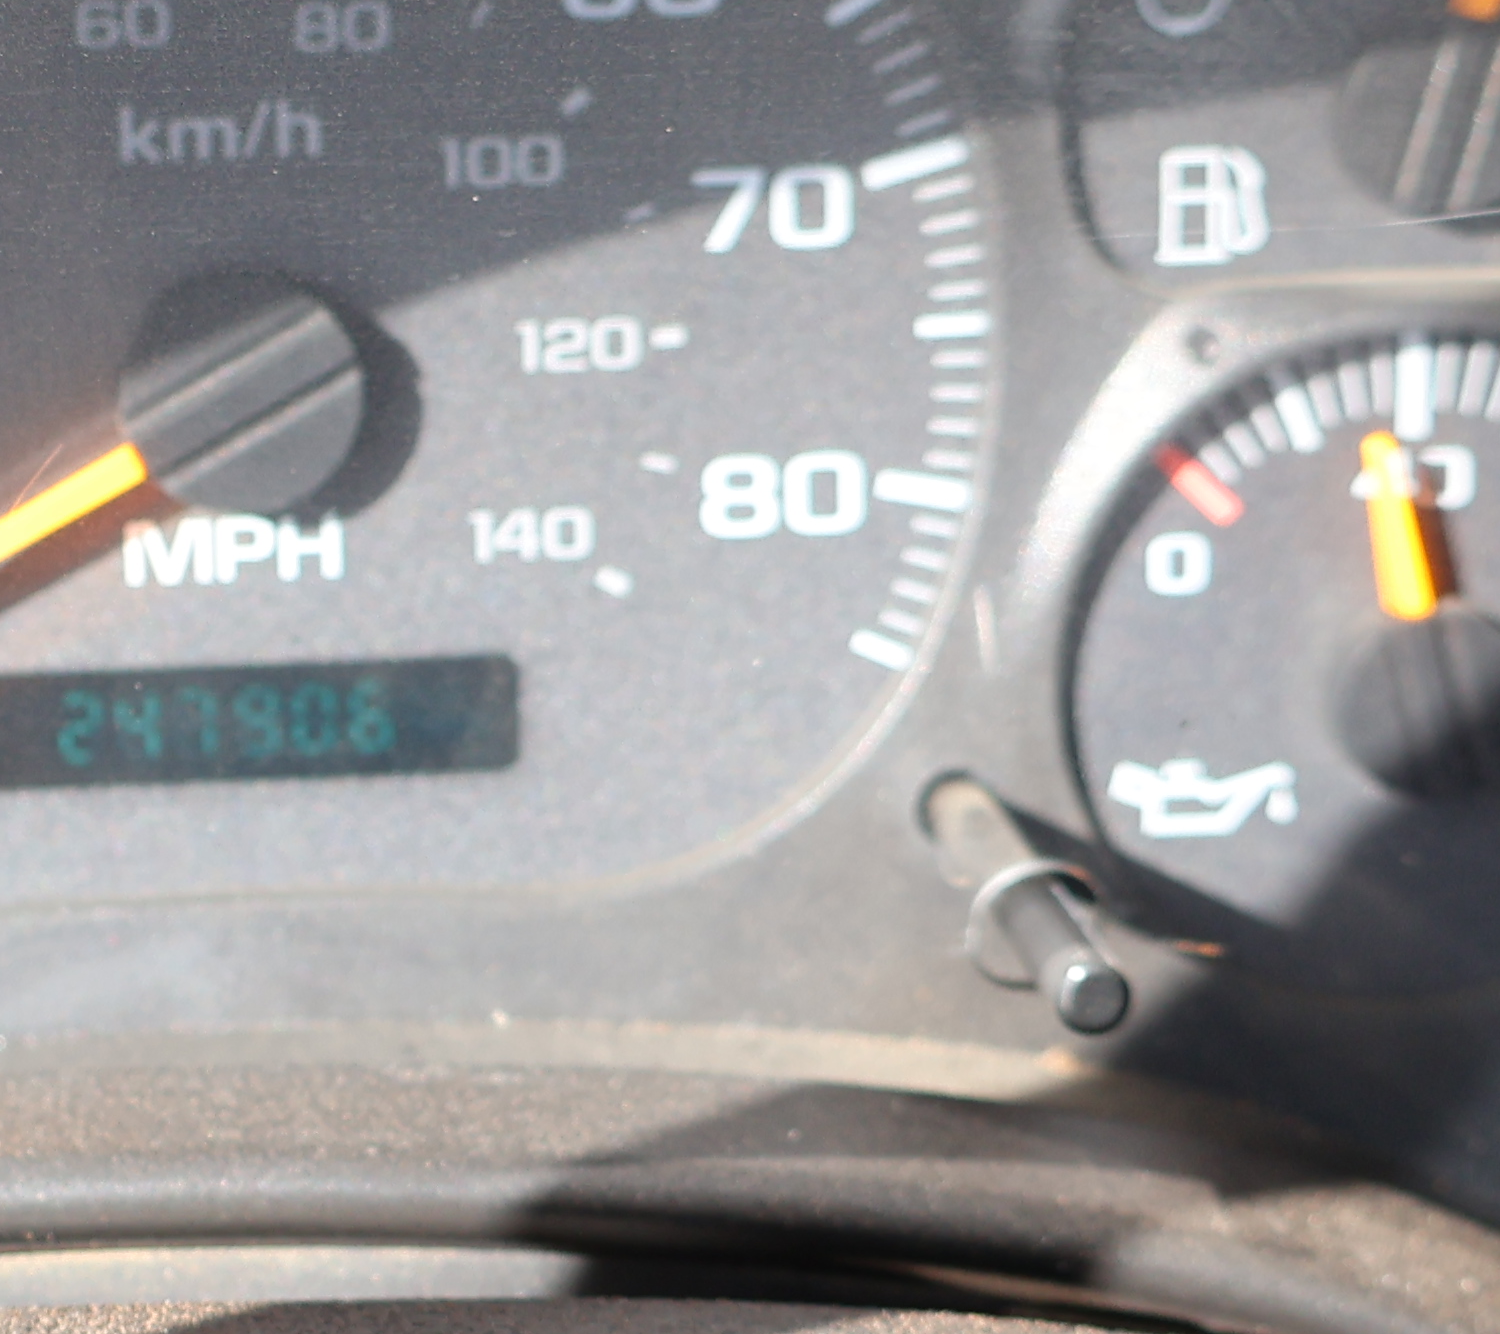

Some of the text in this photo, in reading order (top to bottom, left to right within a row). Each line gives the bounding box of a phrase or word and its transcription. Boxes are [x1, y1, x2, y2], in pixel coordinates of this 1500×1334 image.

[292, 0, 389, 52] 80
[119, 103, 322, 159] km/h
[441, 136, 564, 189] 100
[692, 167, 853, 252] 70
[517, 319, 643, 371] 120
[700, 453, 866, 537] 80
[122, 514, 345, 585] MPH
[469, 508, 594, 562] 140
[1144, 531, 1212, 596] 0
